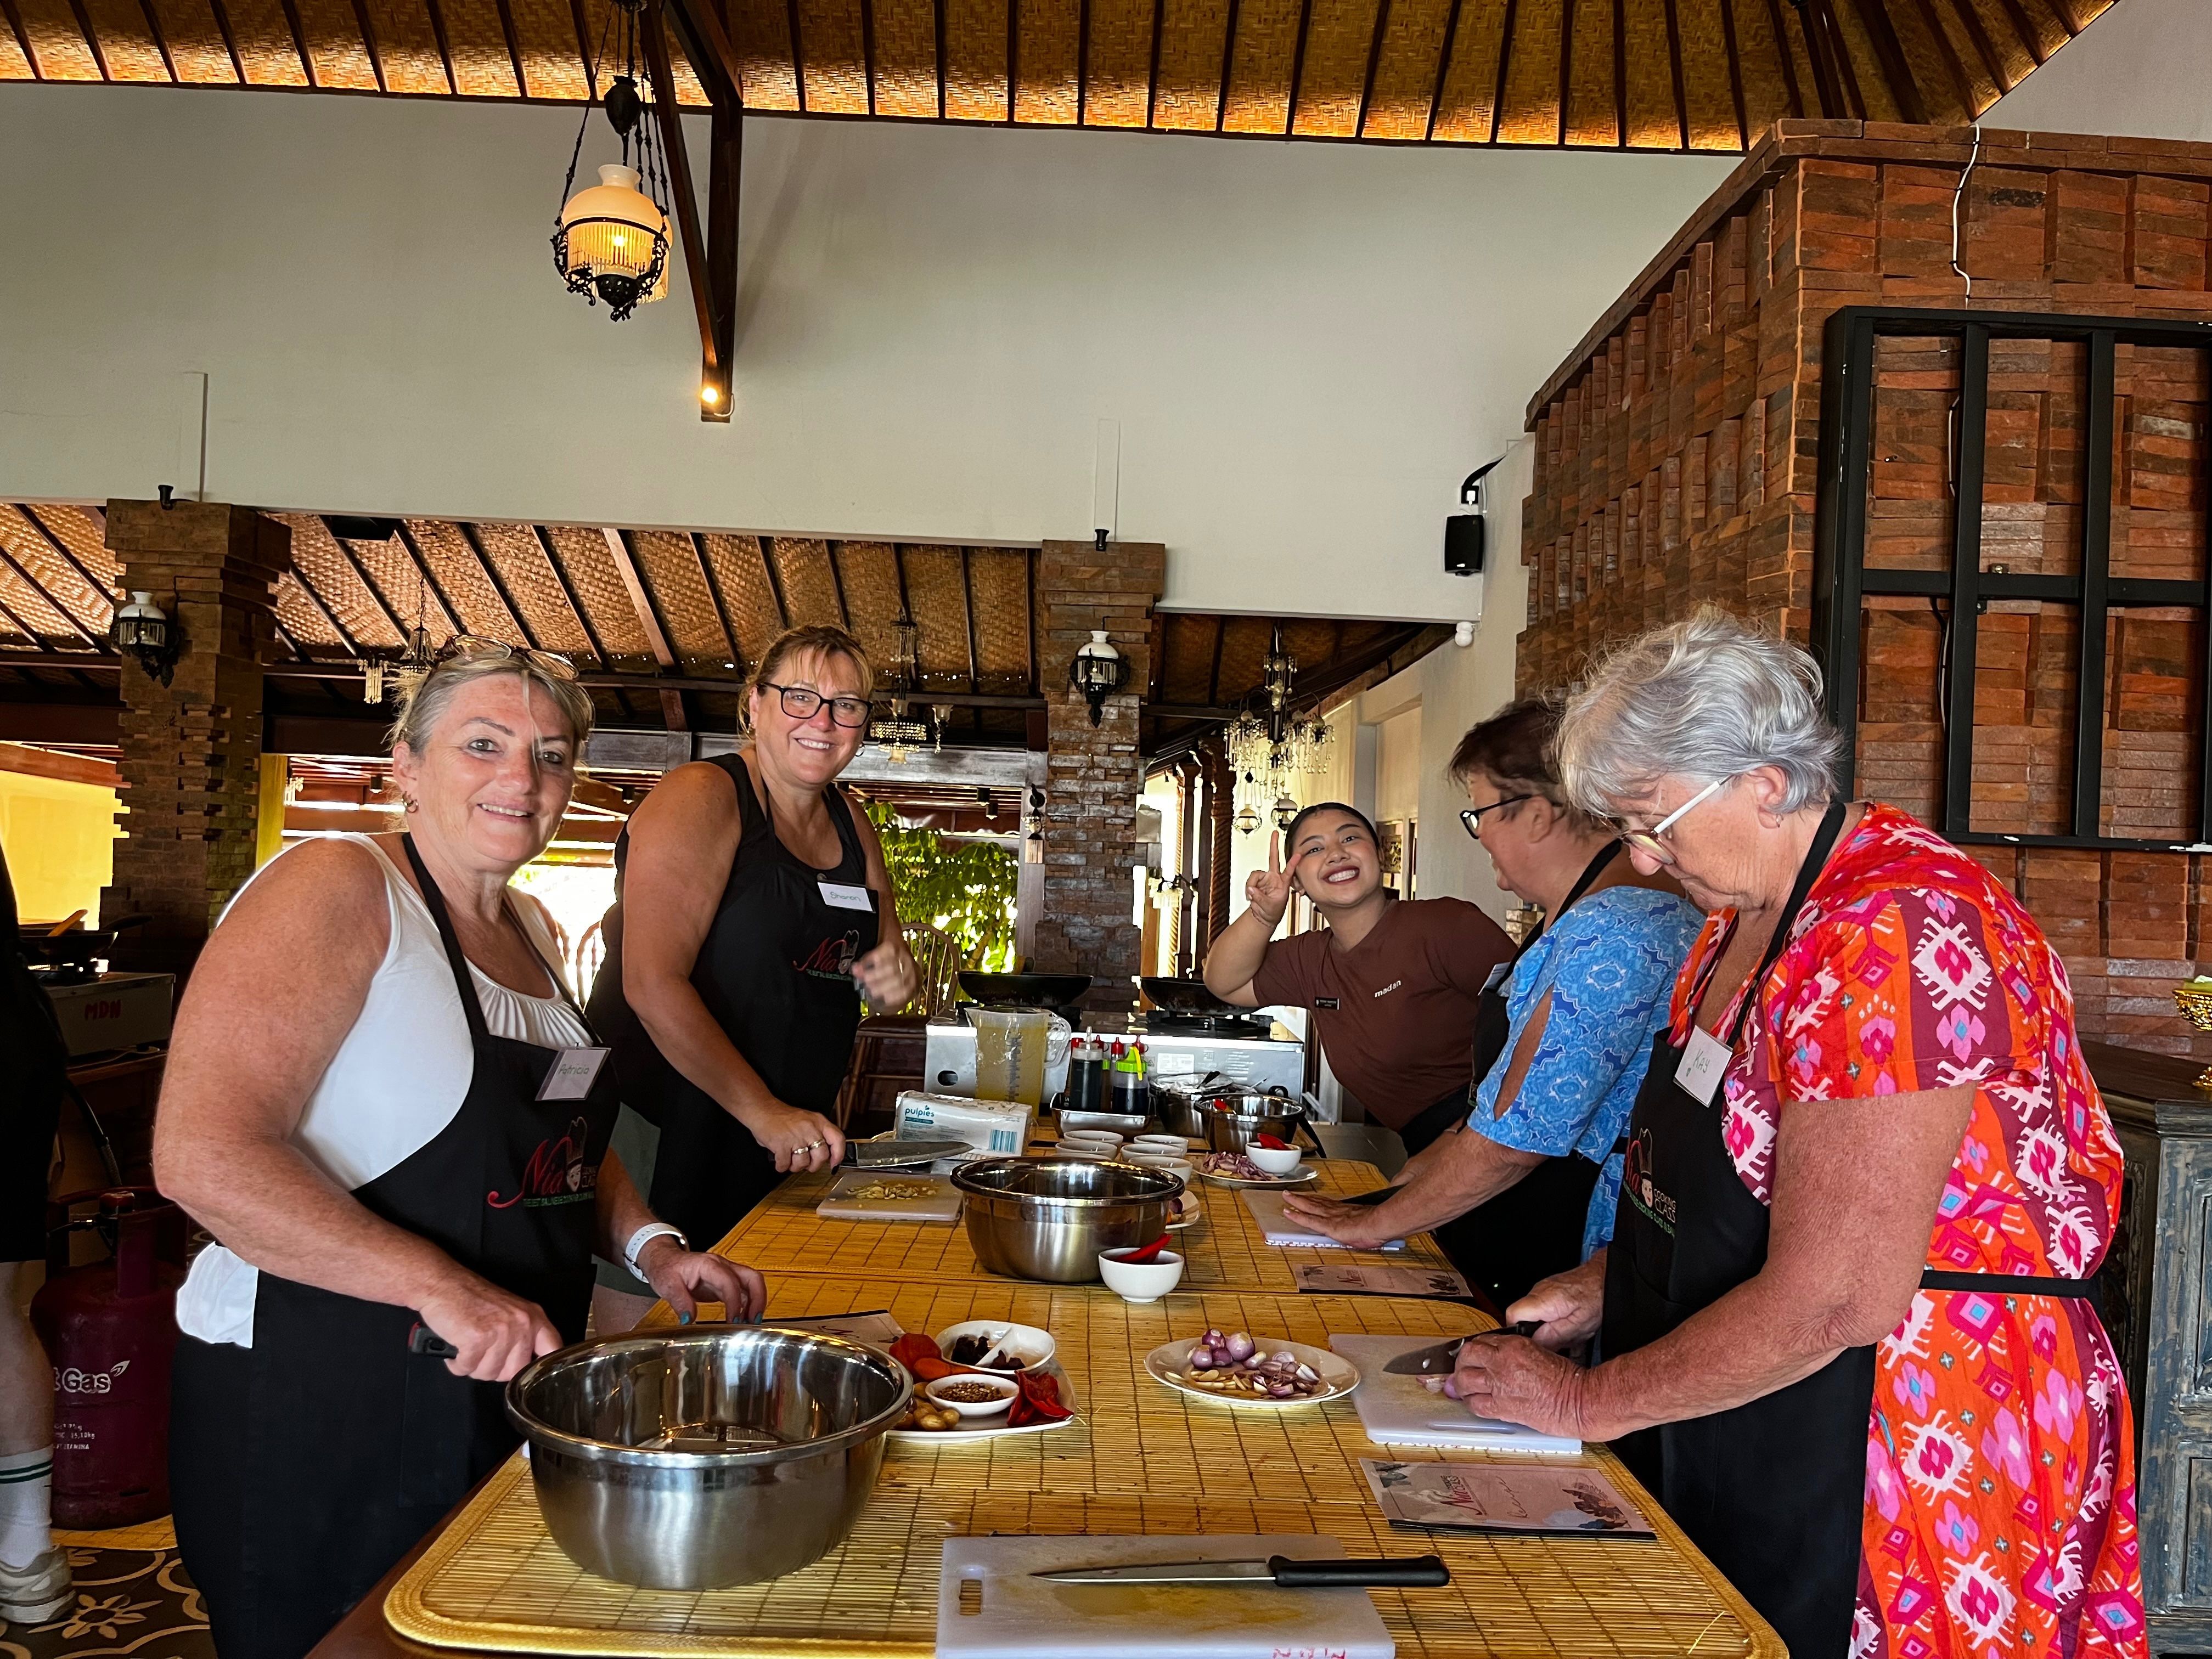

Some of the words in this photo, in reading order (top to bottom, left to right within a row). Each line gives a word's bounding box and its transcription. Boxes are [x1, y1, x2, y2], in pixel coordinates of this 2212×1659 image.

[830, 891, 862, 902] Sharon
[1374, 980, 1401, 998] madan
[85, 999, 121, 1020] MDN
[558, 1063, 589, 1075] Patricia
[905, 1107, 935, 1118] pulpies
[487, 1136, 572, 1208] Nia
[1653, 1188, 1676, 1210] COOKING
[1654, 1198, 1676, 1223] CLASS
[61, 1367, 111, 1394] Gas
